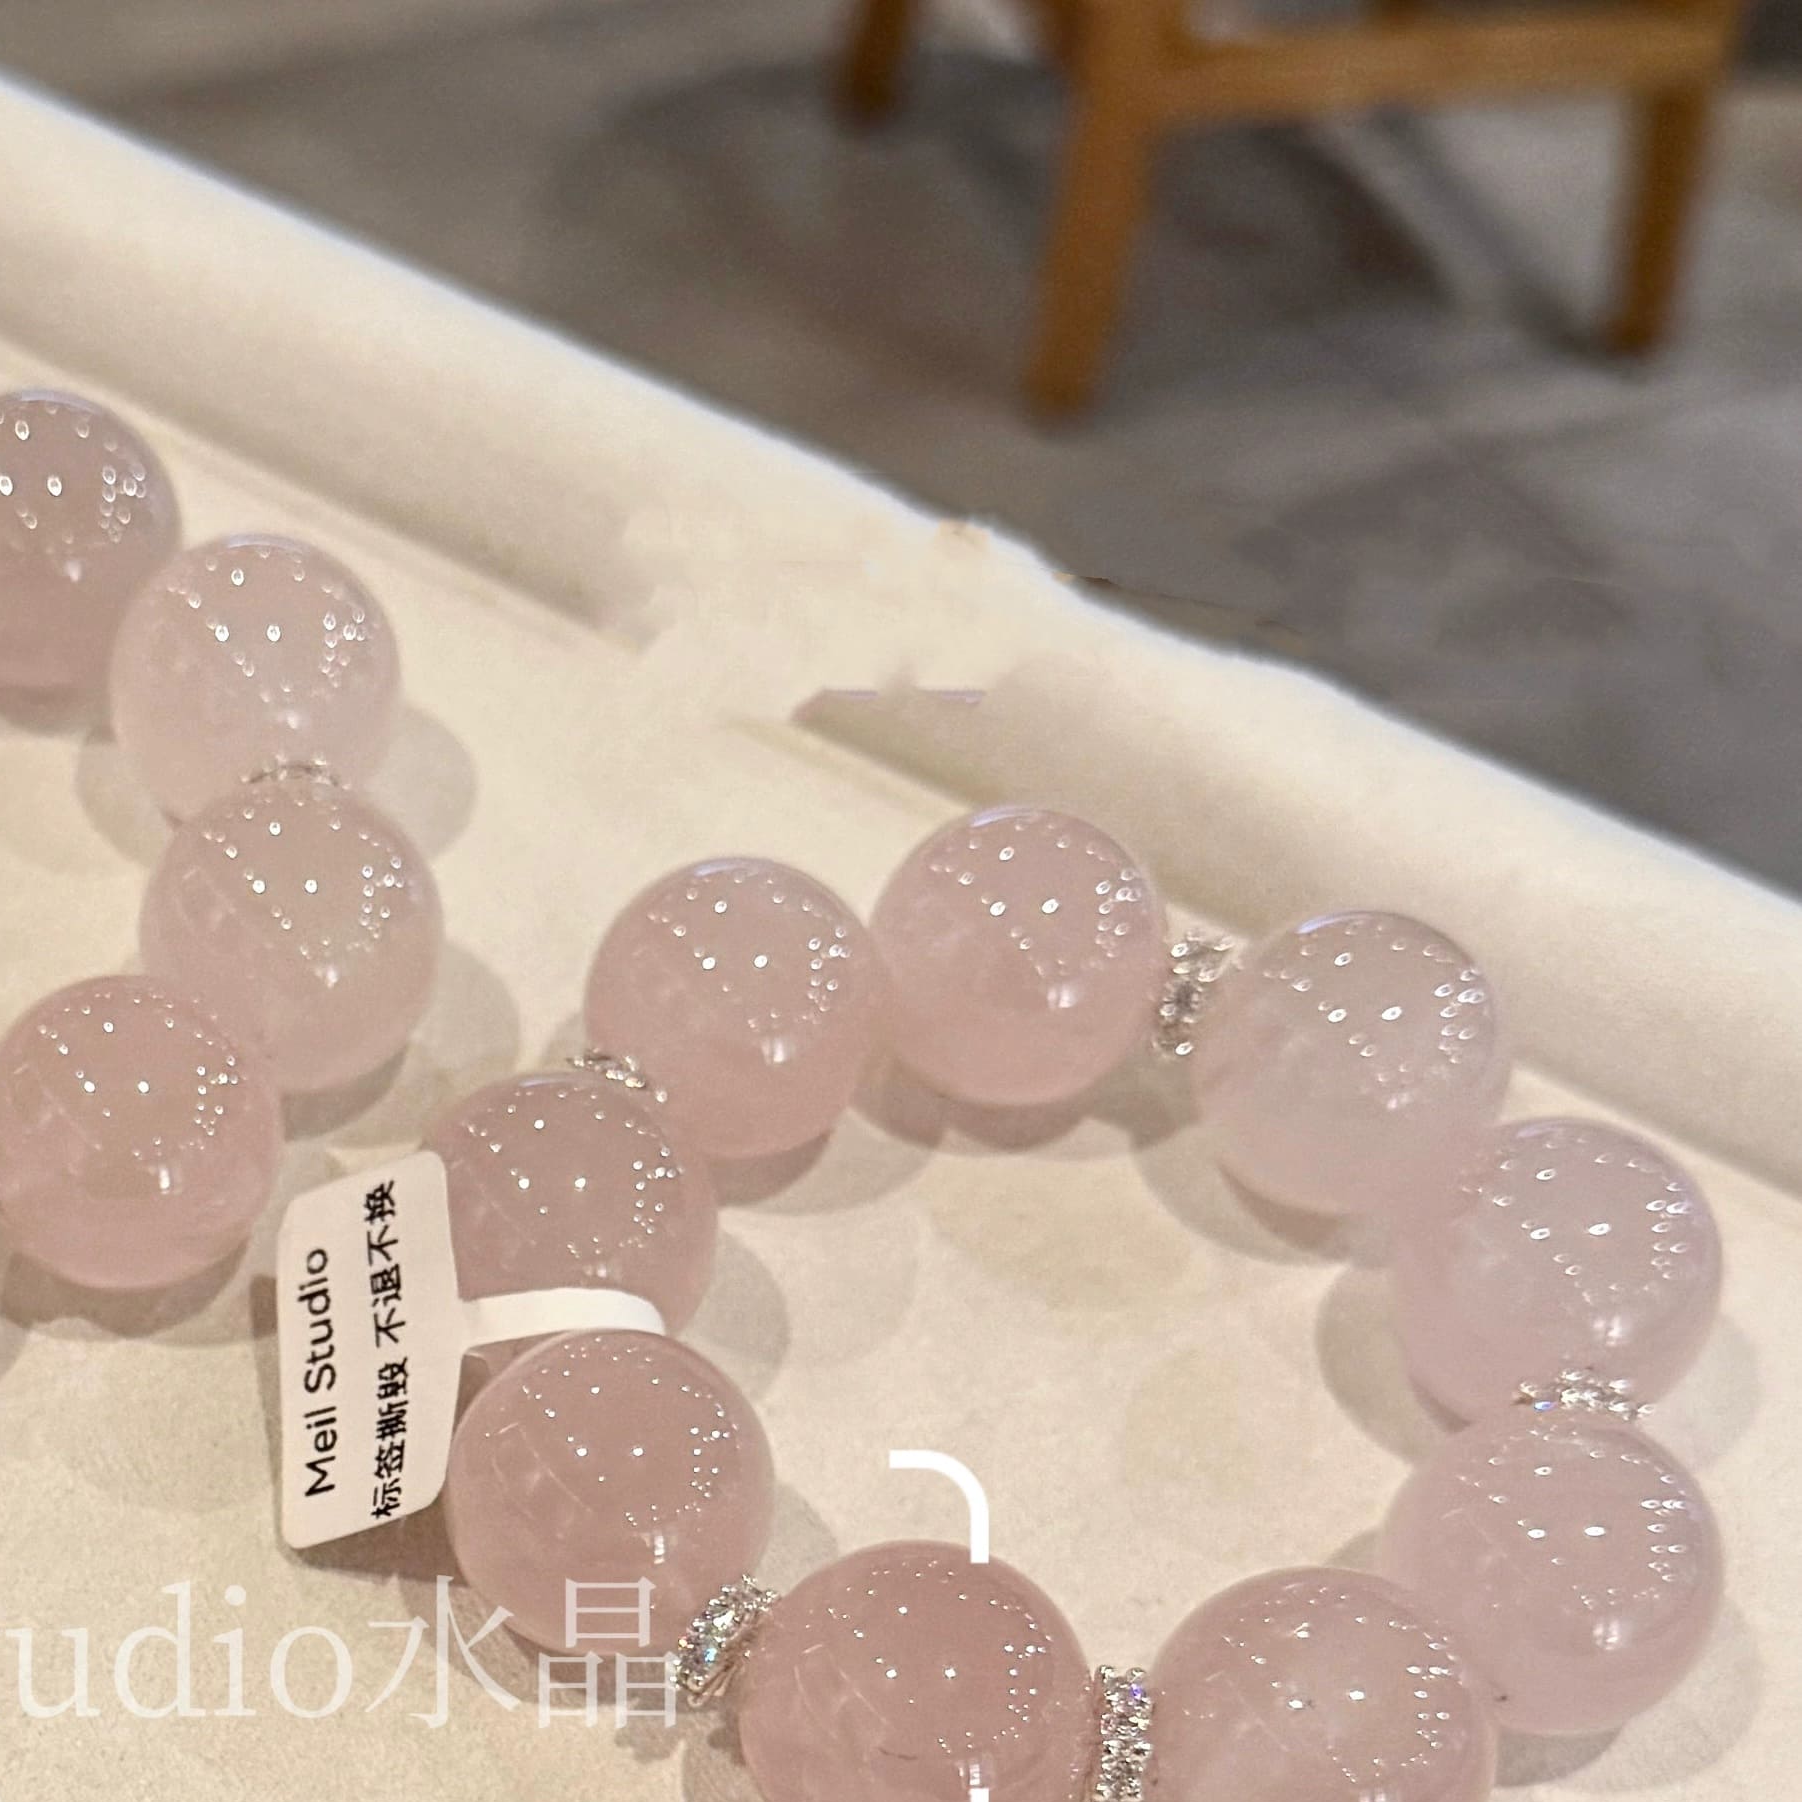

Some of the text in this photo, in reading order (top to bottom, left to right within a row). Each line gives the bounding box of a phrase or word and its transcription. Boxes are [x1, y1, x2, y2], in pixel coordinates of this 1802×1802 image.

[297, 1248, 338, 1498] Meil Studio
[363, 1179, 409, 1521] 标签撕毁 不退不换
